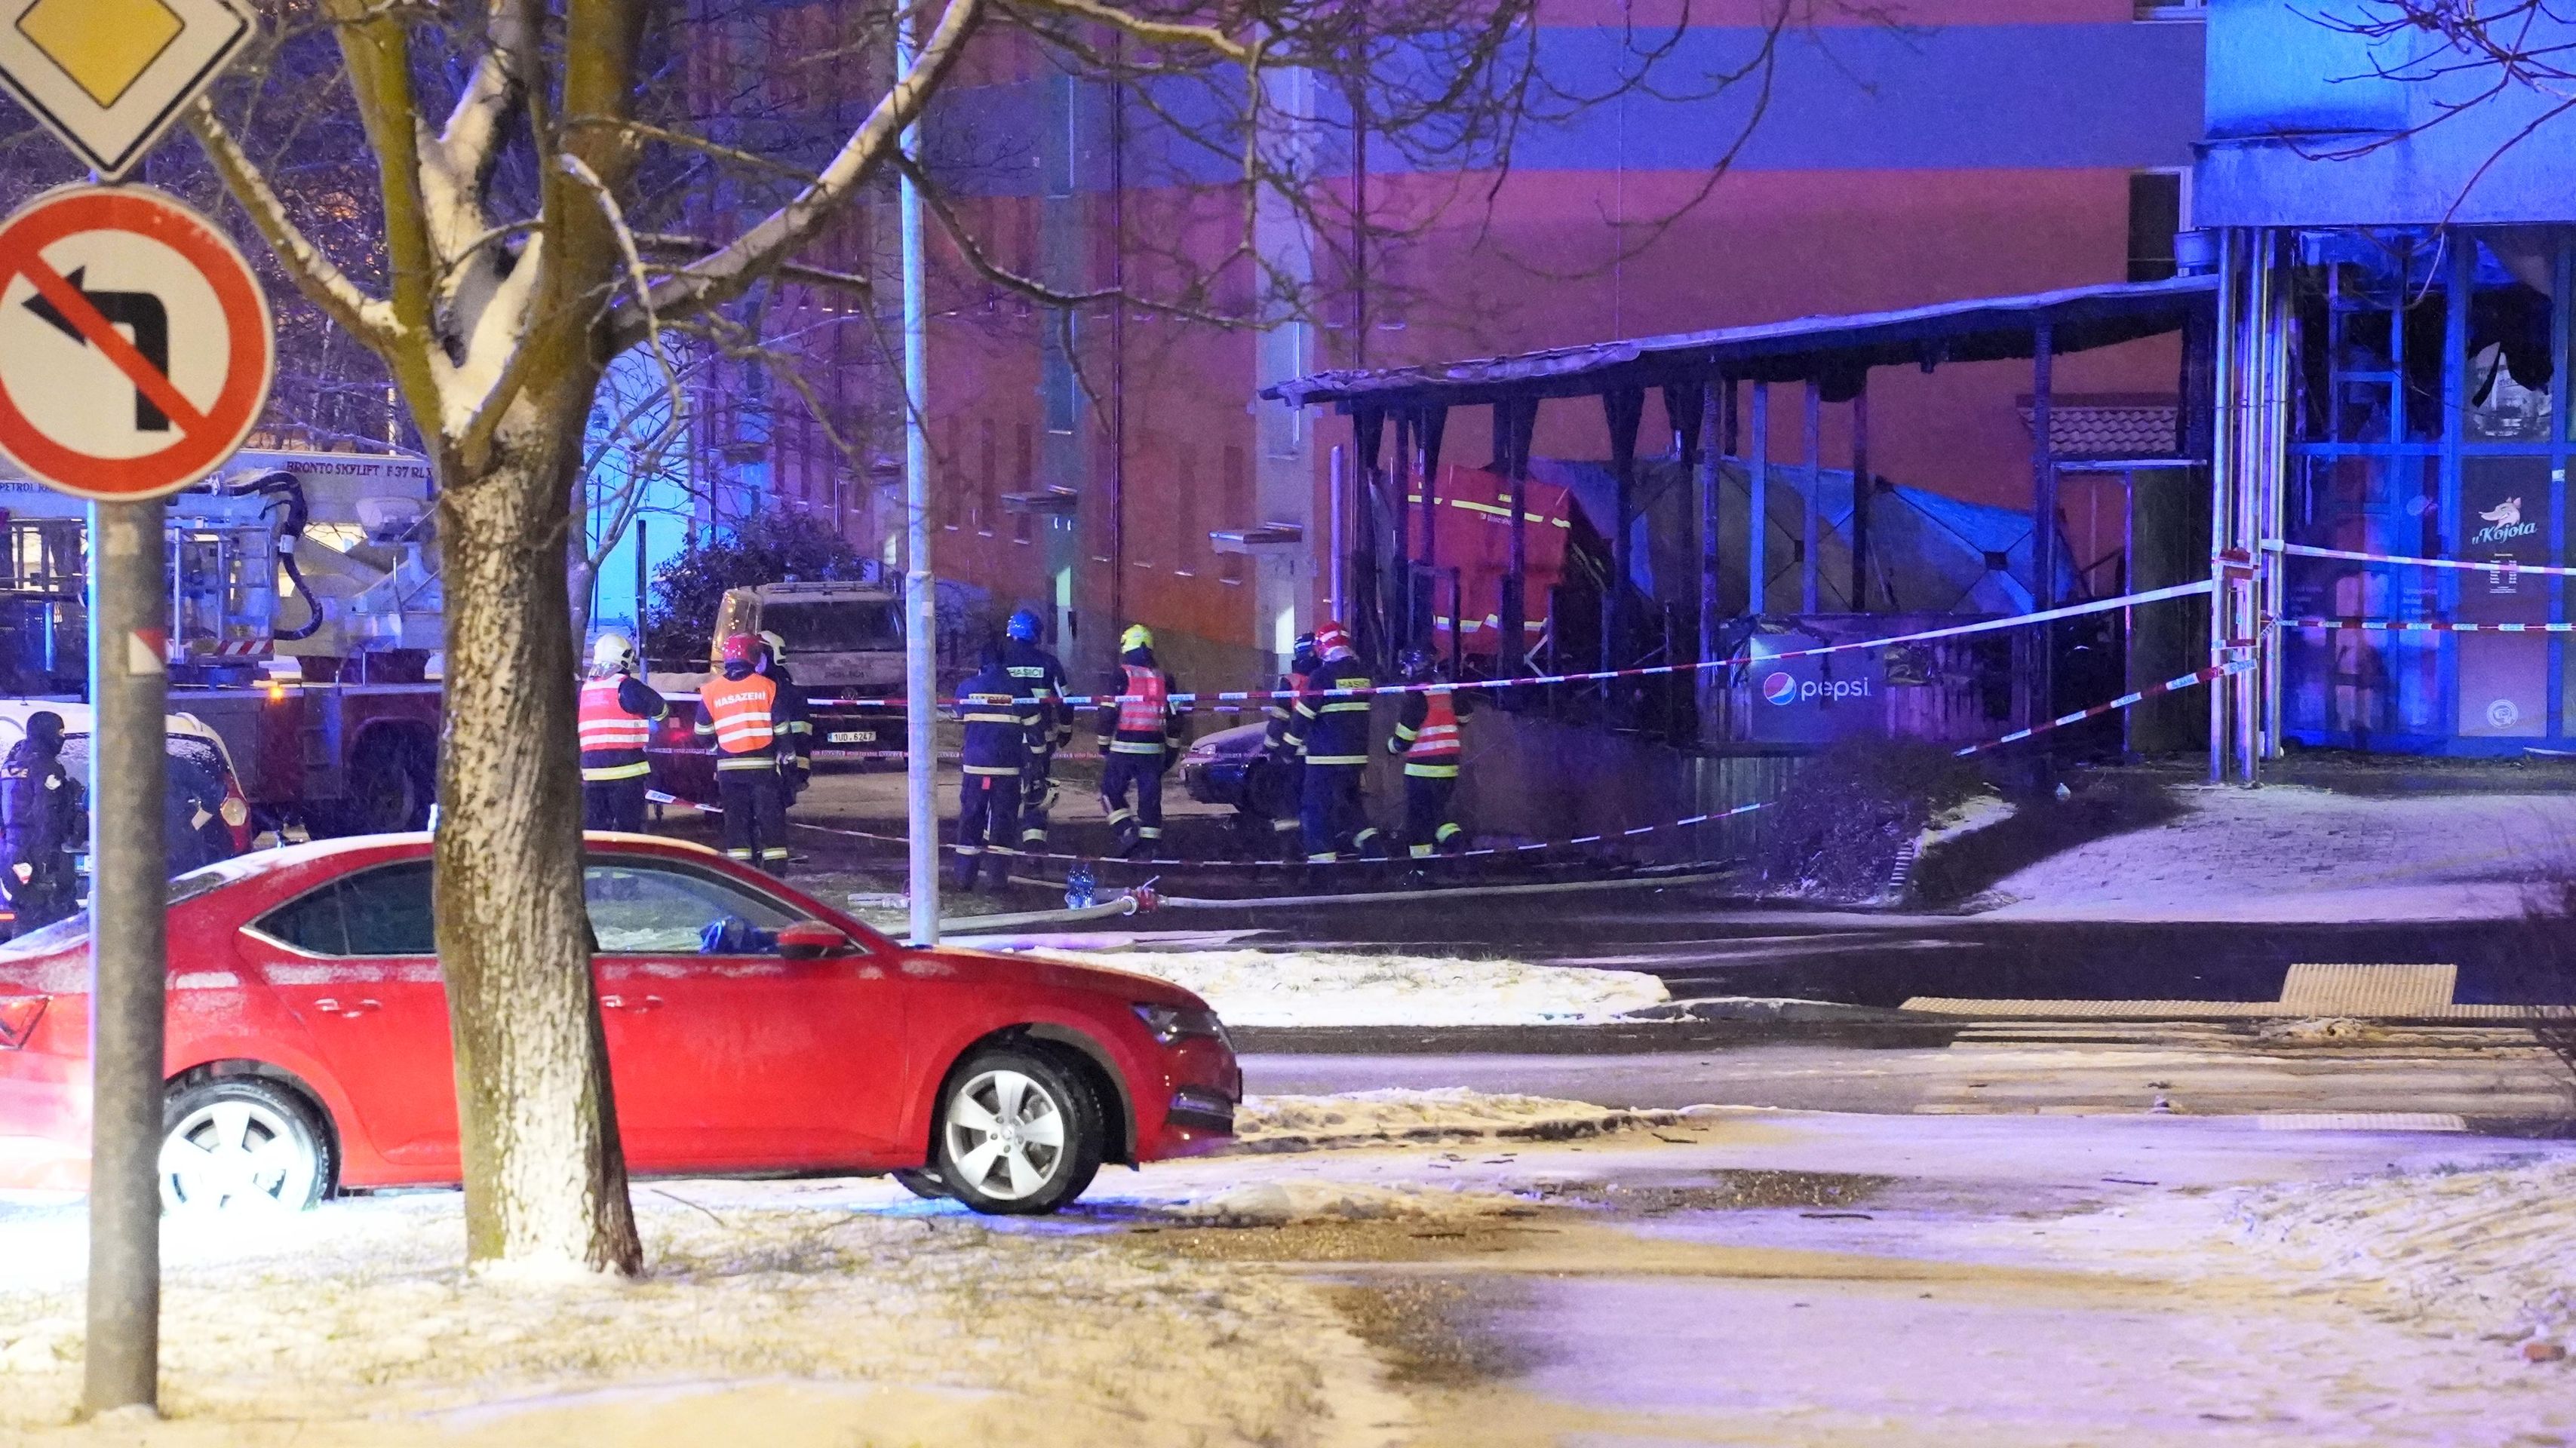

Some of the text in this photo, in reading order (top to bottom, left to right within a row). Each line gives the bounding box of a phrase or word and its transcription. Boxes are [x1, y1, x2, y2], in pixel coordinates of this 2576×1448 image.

[287, 462, 333, 474] BRONTO
[336, 463, 379, 476] SKYLIFT
[395, 466, 409, 477] 37
[2479, 522, 2538, 544] Kojota
[1801, 677, 1868, 701] pepsi
